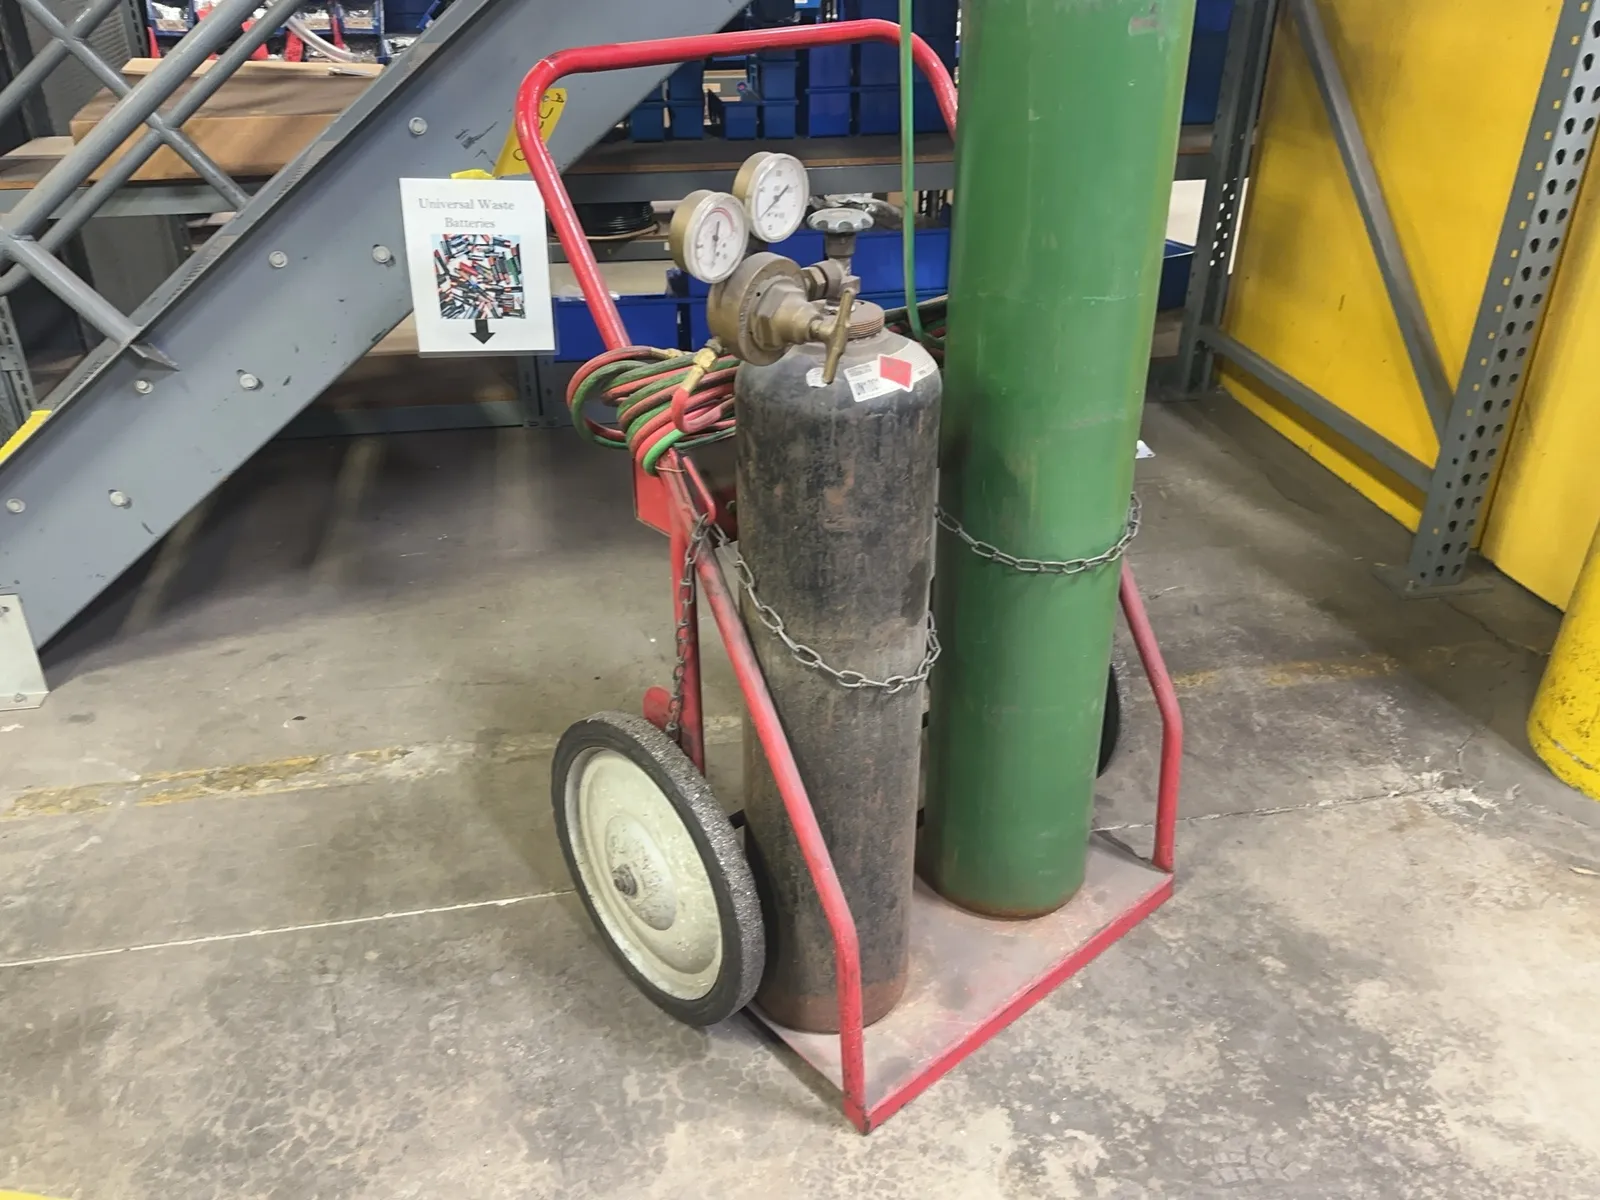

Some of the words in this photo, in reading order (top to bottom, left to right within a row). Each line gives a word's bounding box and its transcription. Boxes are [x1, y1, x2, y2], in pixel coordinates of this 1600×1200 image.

[418, 198, 475, 210] Universal
[477, 199, 515, 210] Waste
[444, 216, 496, 229] Batteries
